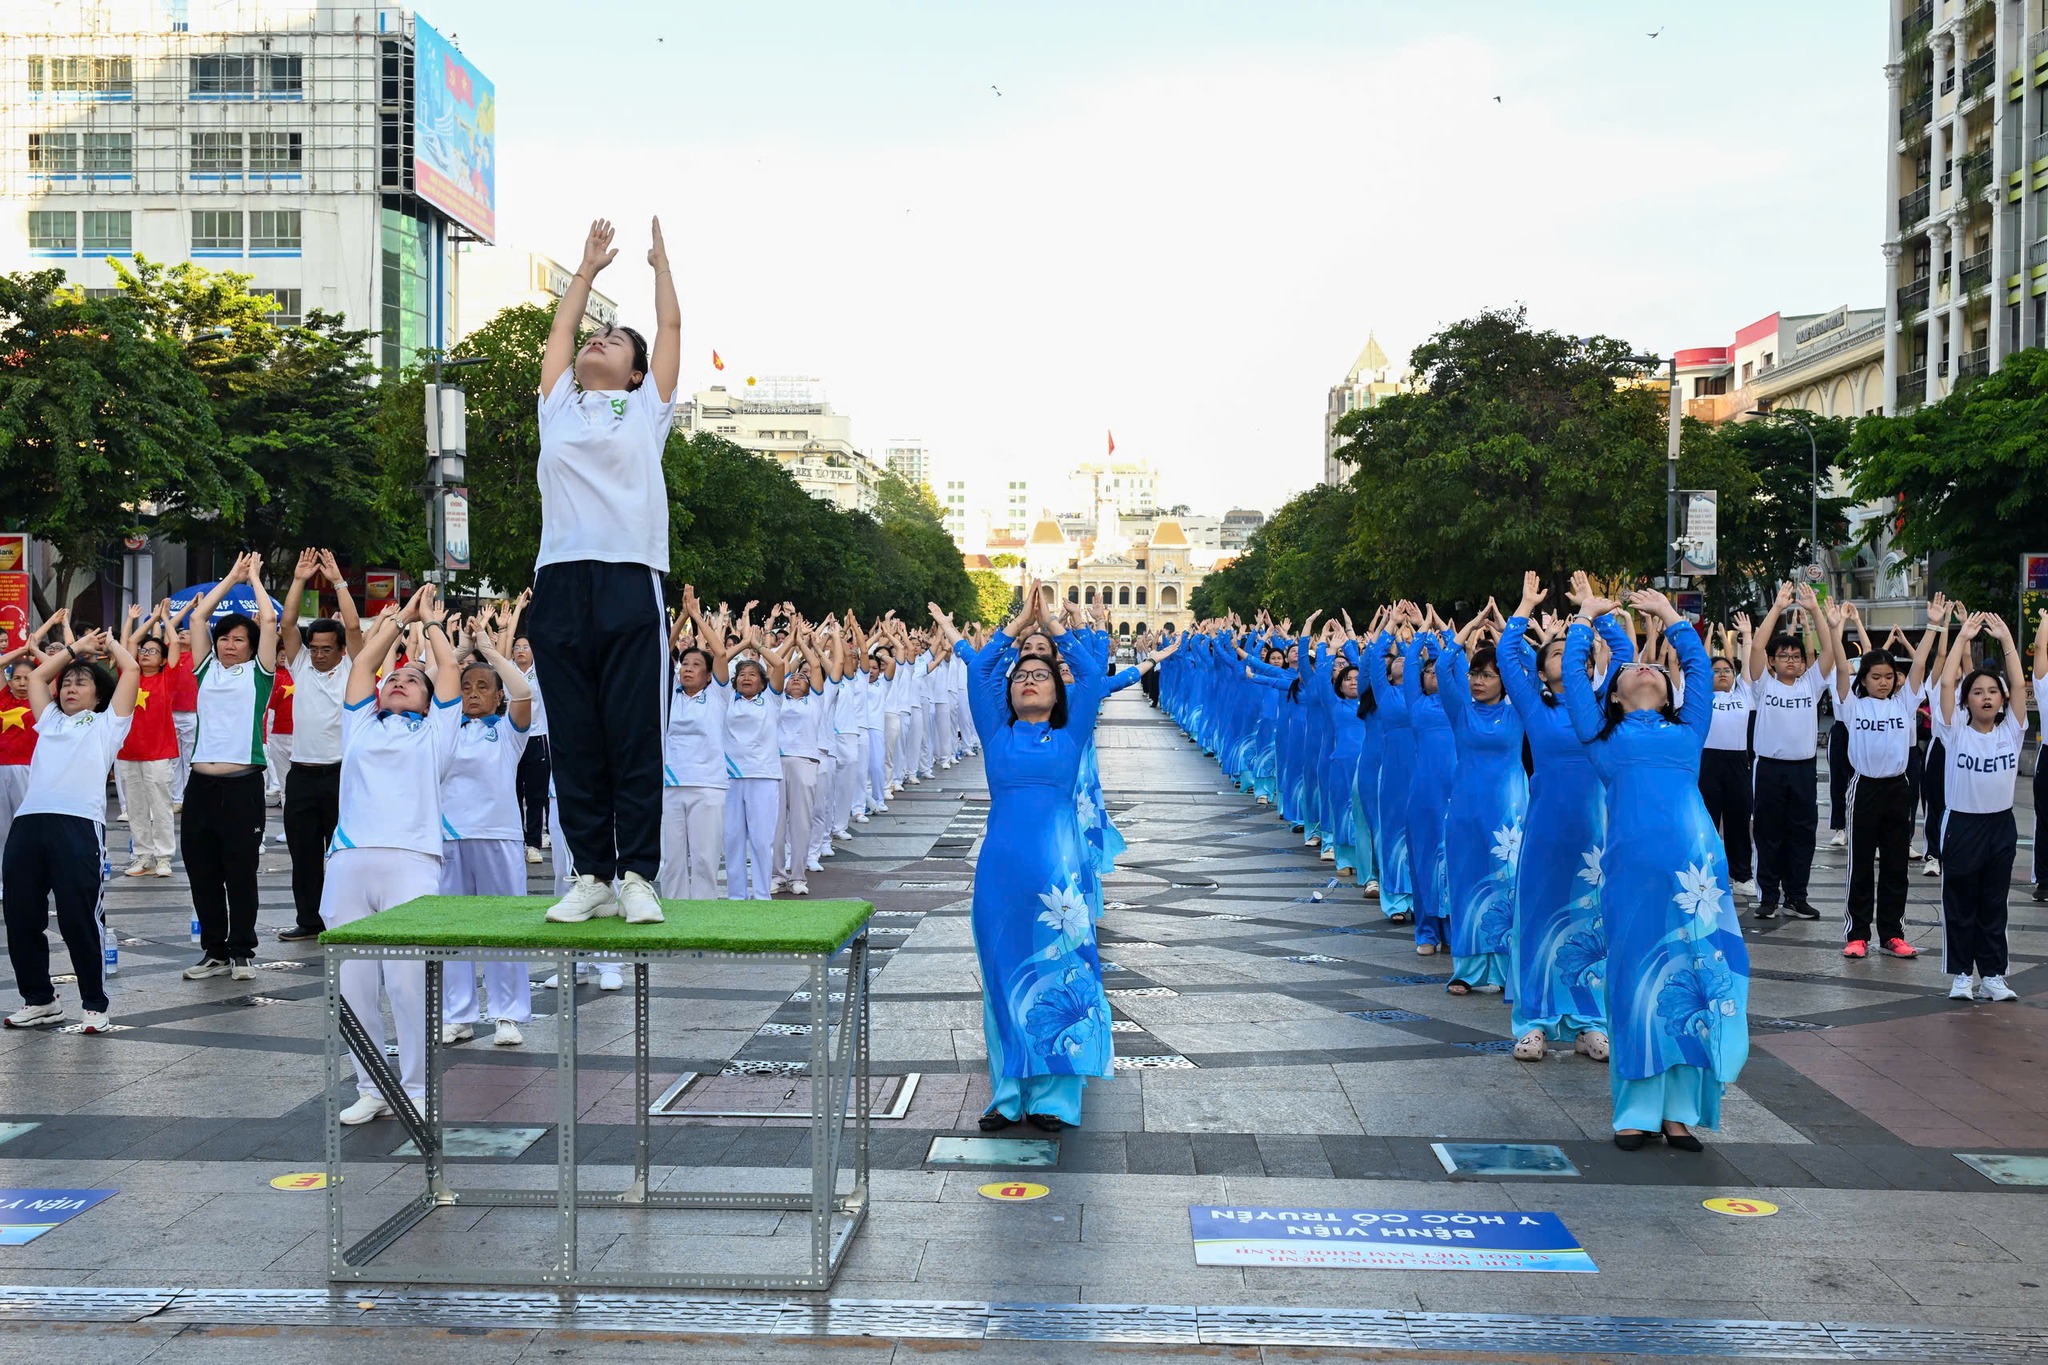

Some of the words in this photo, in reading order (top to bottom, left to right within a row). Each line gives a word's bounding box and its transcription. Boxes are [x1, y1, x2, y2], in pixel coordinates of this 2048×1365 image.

[796, 467, 812, 477] REX
[815, 468, 852, 480] HOTEL
[1765, 695, 1812, 708] COLETTE
[23, 1196, 87, 1212] VIỆN
[1211, 1210, 1342, 1224] TRUYỀN
[1352, 1213, 1409, 1227] CỔ
[1420, 1213, 1506, 1225] HỌC
[1518, 1216, 1541, 1225] Y
[1286, 1224, 1370, 1238] VIỆN
[1380, 1226, 1476, 1240] BỆNH
